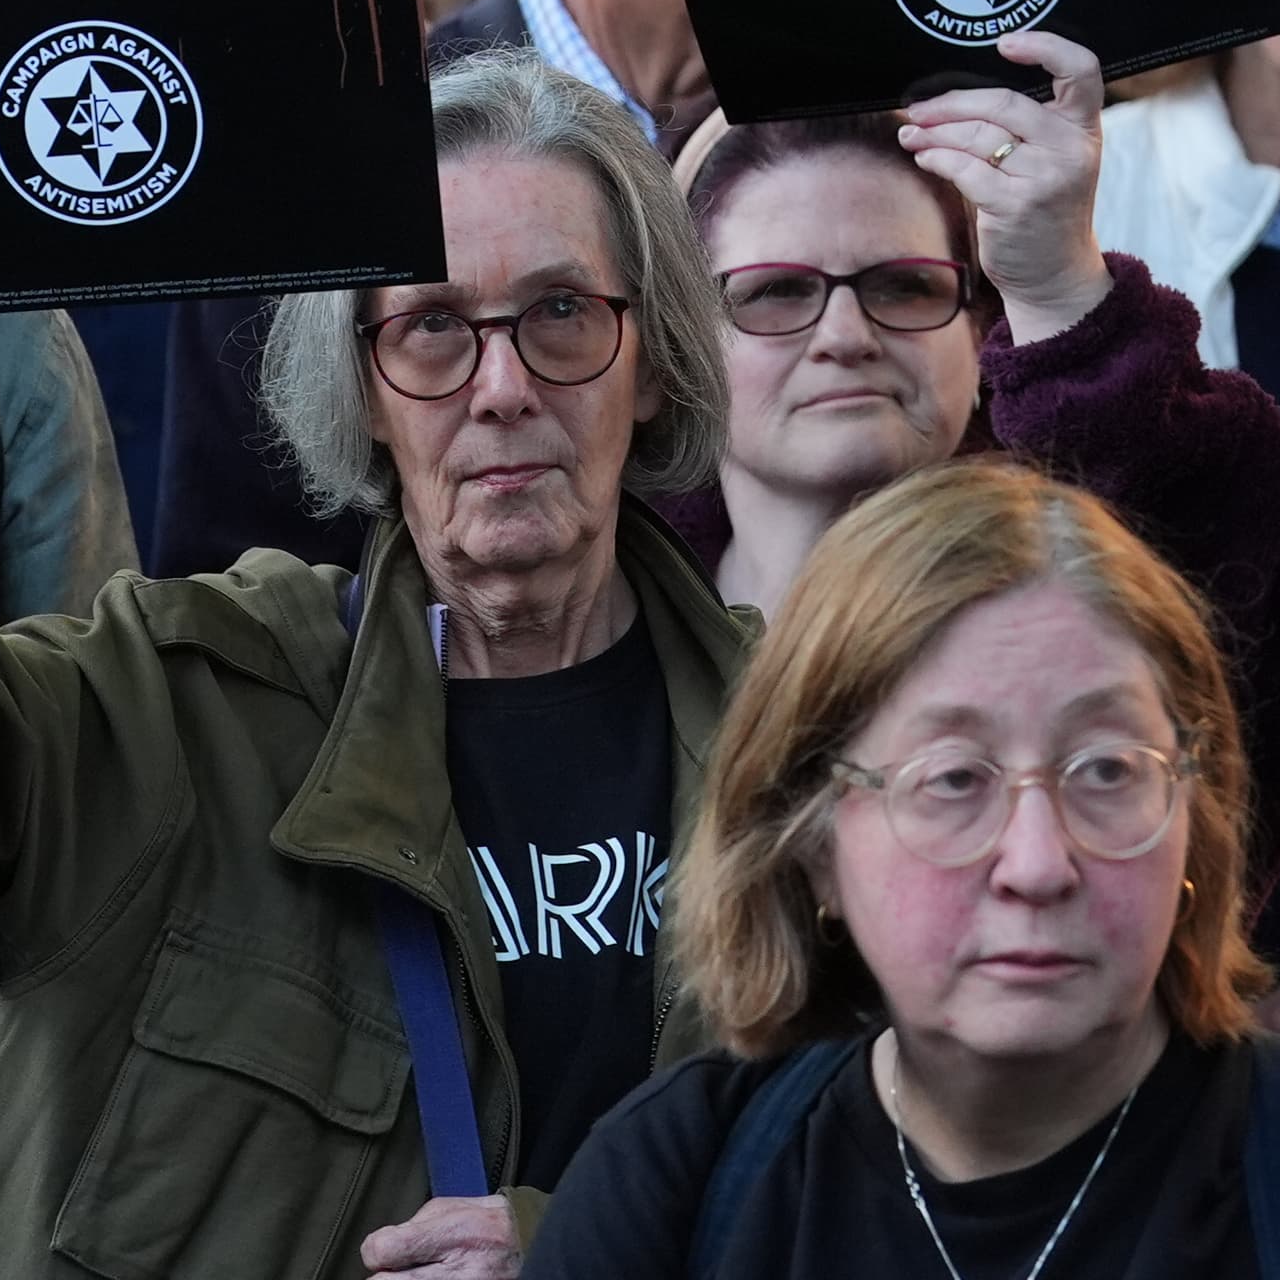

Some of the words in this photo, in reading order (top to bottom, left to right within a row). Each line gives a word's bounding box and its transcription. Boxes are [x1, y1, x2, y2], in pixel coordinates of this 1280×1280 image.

[1, 32, 95, 118] CAMPAIGN
[102, 33, 188, 107] AGAINST
[24, 162, 178, 215] ANTISEMITISM
